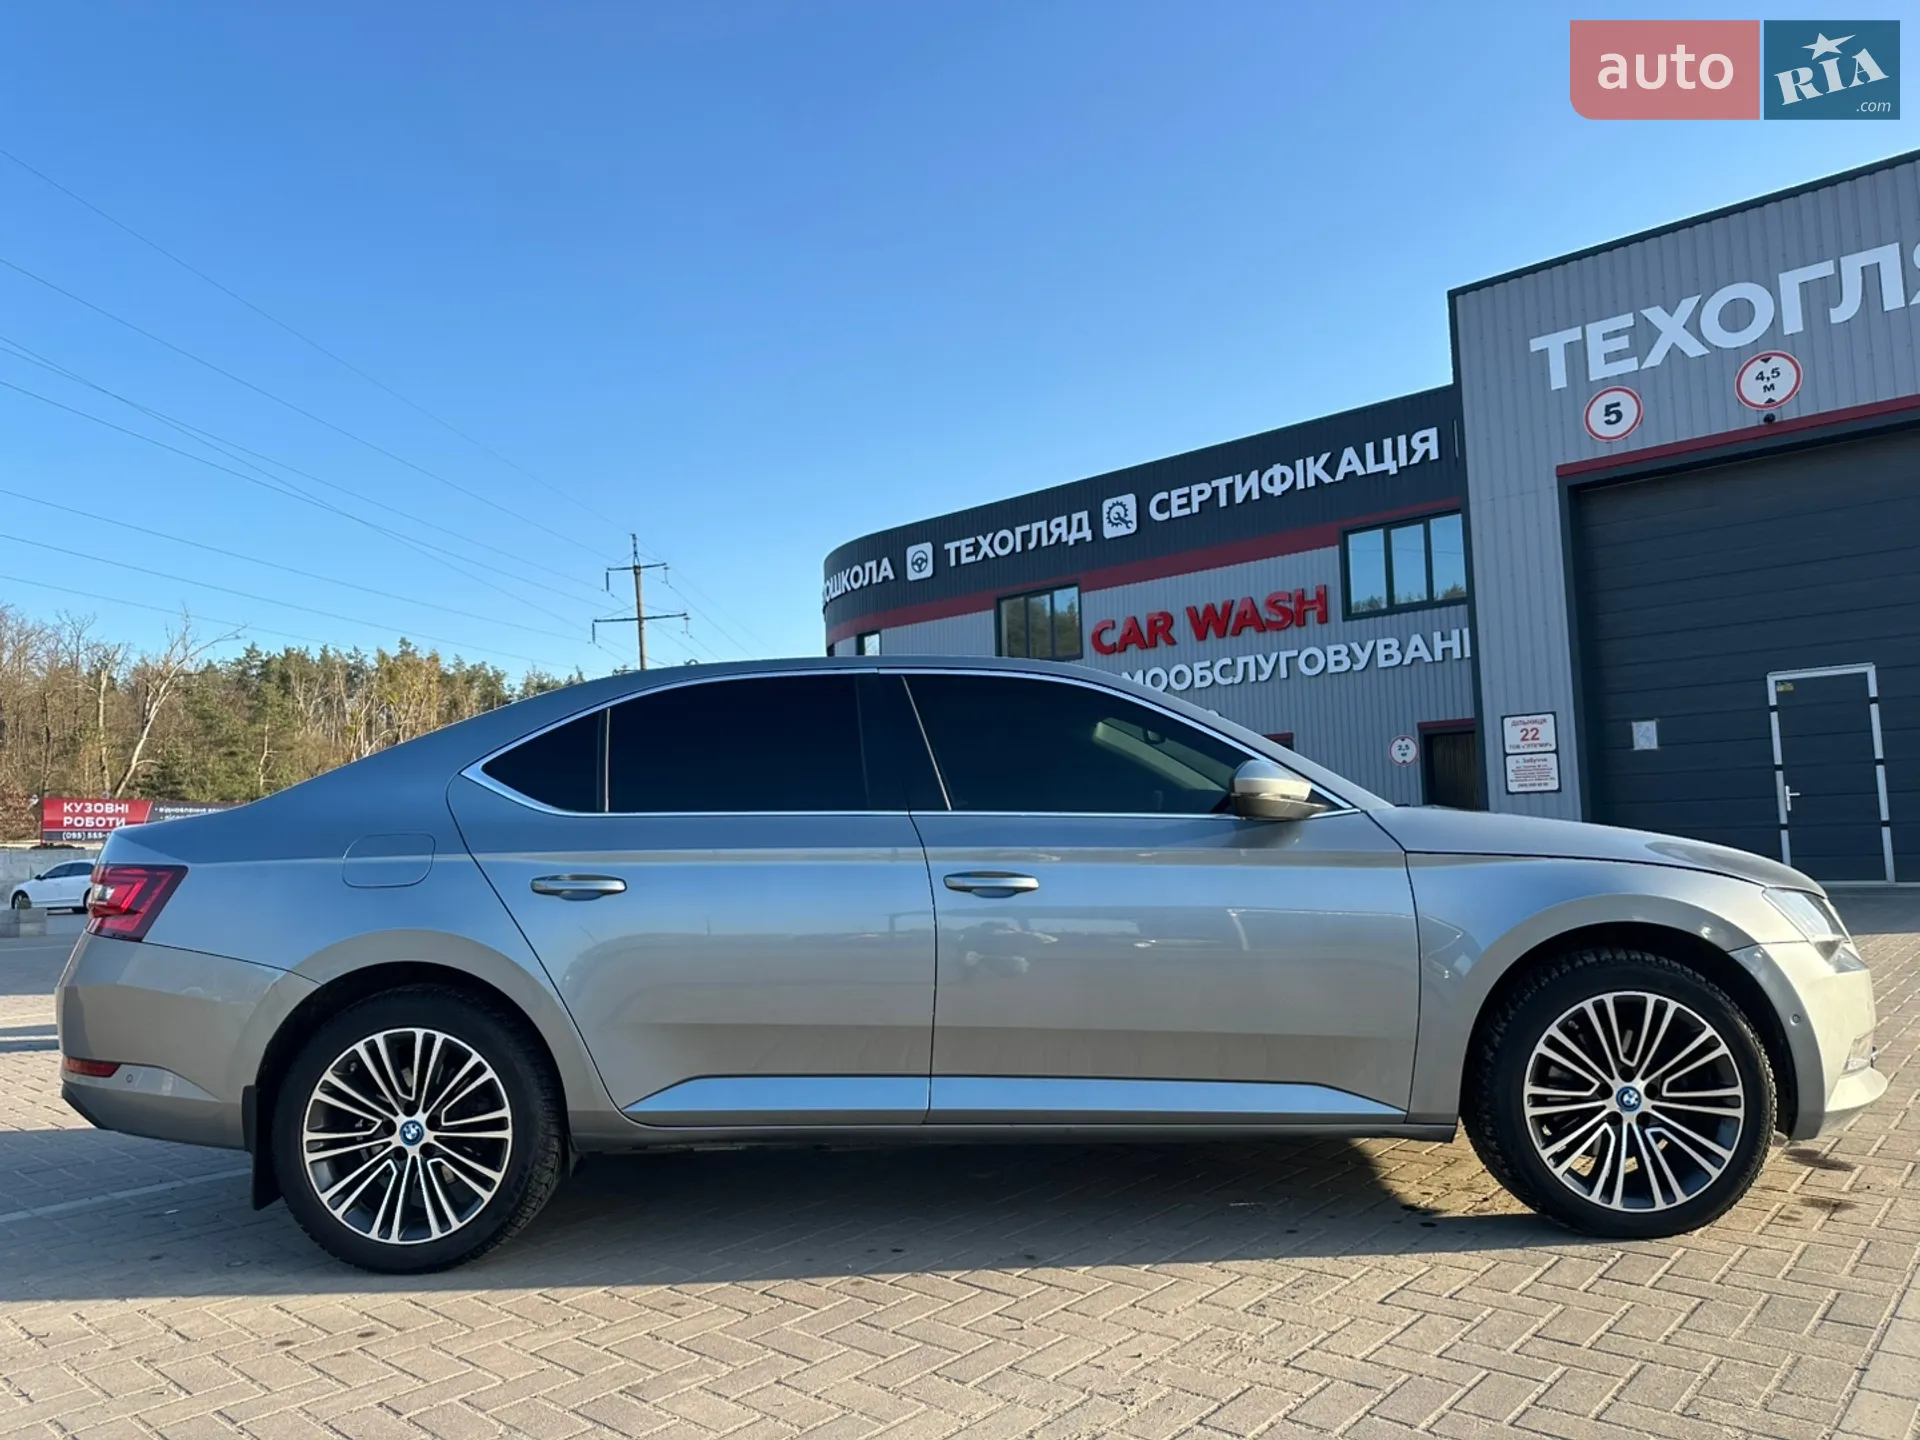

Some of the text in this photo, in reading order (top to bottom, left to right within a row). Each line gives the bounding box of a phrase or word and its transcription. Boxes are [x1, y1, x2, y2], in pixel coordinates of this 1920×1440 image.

[1529, 242, 1920, 391] ТЕХОГЛ
[1755, 367, 1781, 382] 4,5
[1604, 402, 1624, 426] 5
[822, 427, 1440, 605] ОШКОЛА ТЕХОГЛЯД СЕРТИФІКАЦІЯ
[1091, 584, 1328, 655] CAR WASH
[1520, 727, 1541, 742] 22
[63, 802, 129, 813] КУЗОВНІ
[63, 816, 126, 827] РОБОТИ
